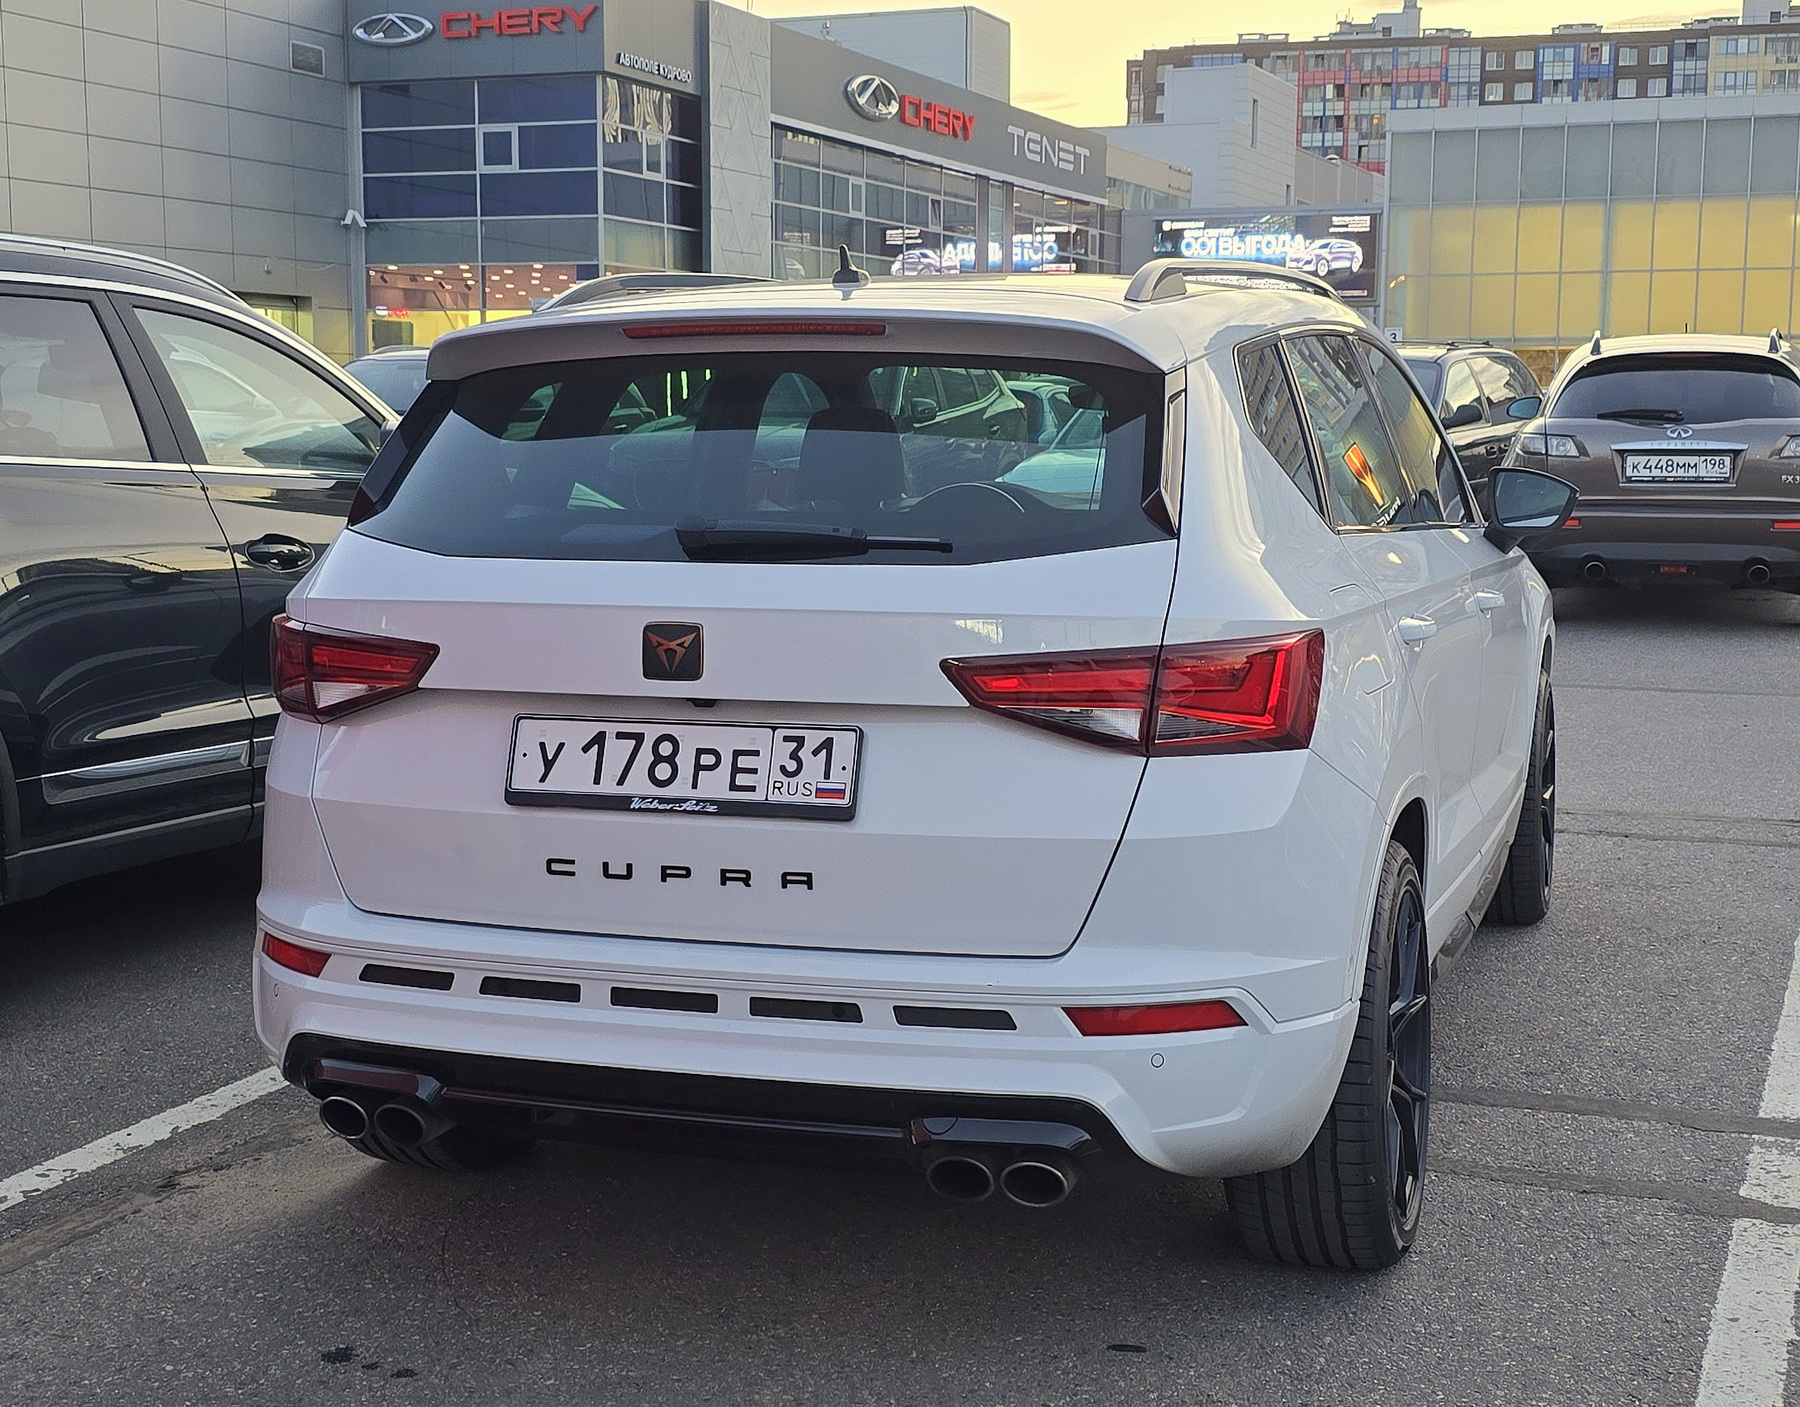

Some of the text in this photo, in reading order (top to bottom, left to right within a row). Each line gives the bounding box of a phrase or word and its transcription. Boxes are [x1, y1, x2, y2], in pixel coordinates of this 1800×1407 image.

[440, 4, 598, 38] CHERY
[618, 52, 692, 83] АВТОПОЛЕ КУДРОВО
[901, 94, 977, 142] CHERY
[1007, 125, 1091, 175] TENET
[1218, 234, 1306, 256] ВЫГОДА
[1701, 457, 1727, 470] 198
[779, 735, 834, 780] 31
[771, 780, 813, 796] RUS
[545, 856, 813, 890] CUPRA
